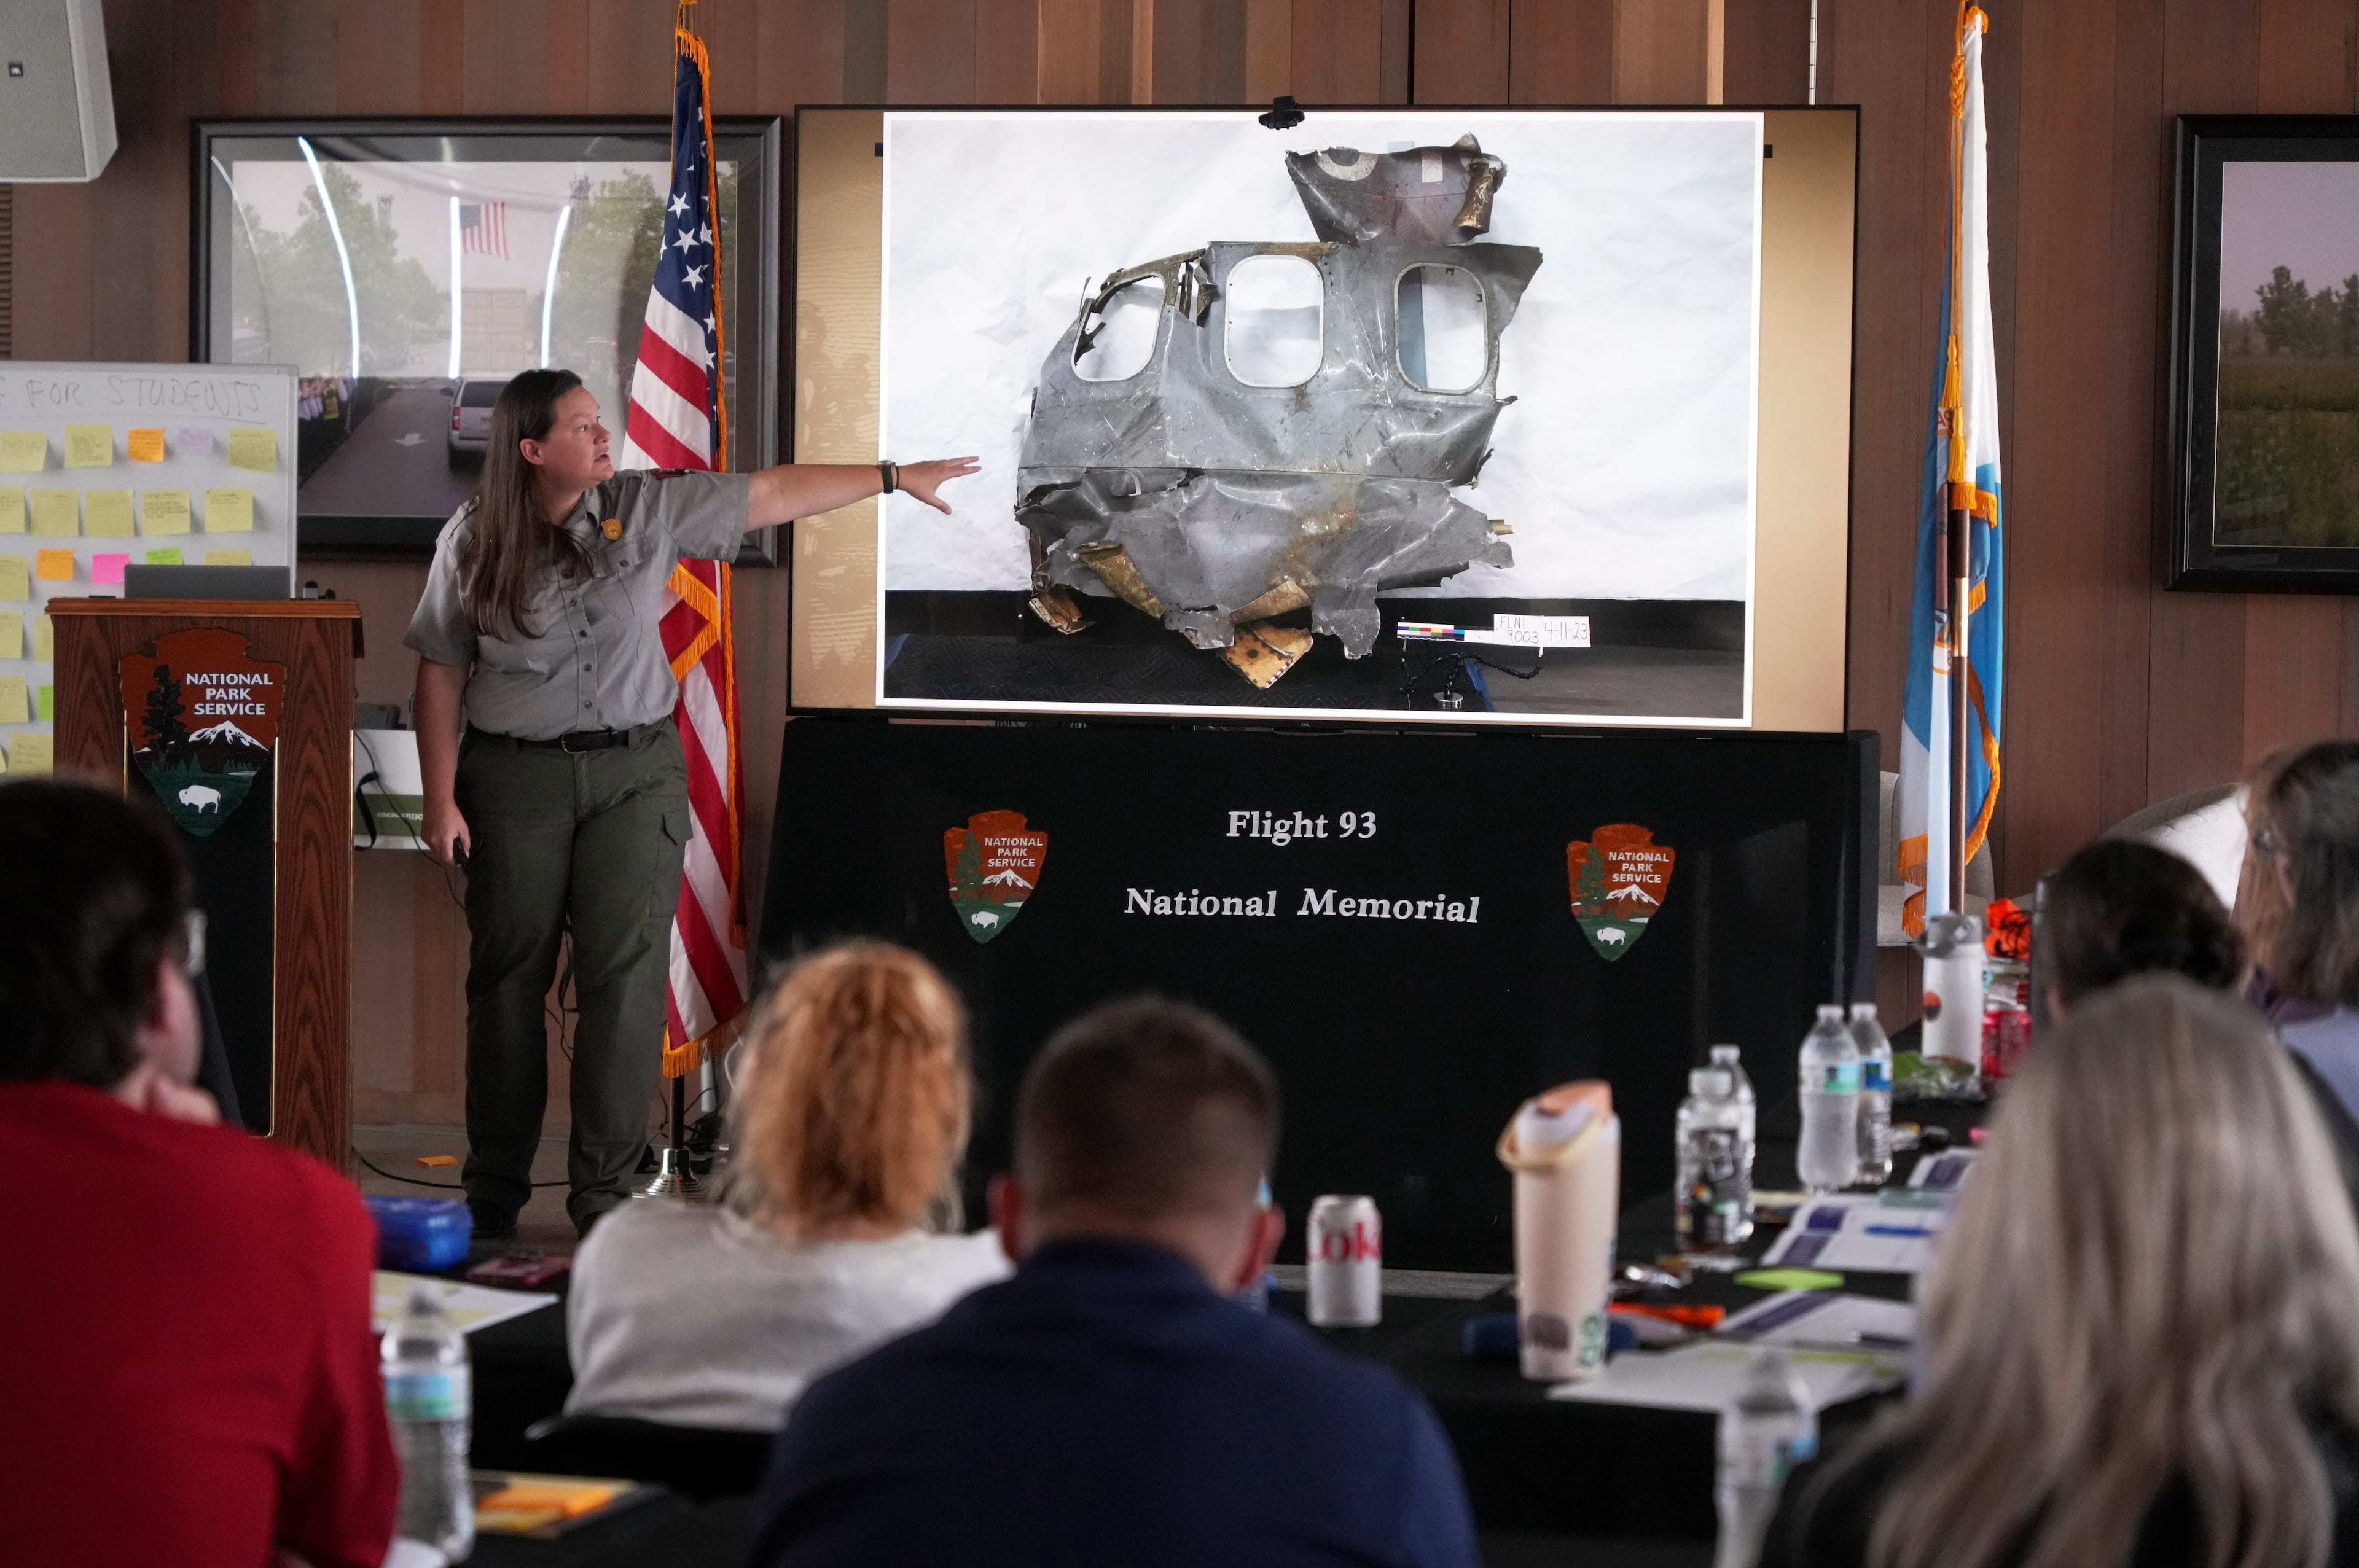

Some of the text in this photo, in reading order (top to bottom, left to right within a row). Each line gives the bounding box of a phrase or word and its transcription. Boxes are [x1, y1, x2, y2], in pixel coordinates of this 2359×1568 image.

[26, 378, 81, 407] FOR
[107, 376, 260, 417] STUDENTS
[1507, 630, 1539, 644] 9003
[1544, 620, 1588, 642] 4-11-23
[186, 673, 273, 685] NATIONAL
[206, 688, 251, 700] PARK
[194, 703, 266, 716] SERVICE
[1226, 811, 1377, 846] Flight 93
[984, 837, 1043, 846] NATIONAL
[997, 848, 1028, 857] PARK
[1608, 852, 1669, 862] NATIONAL
[988, 859, 1035, 867] SERVICE
[1622, 863, 1654, 872] PARK
[1612, 873, 1662, 883] SERVICE
[1124, 888, 1480, 923] National Memorial
